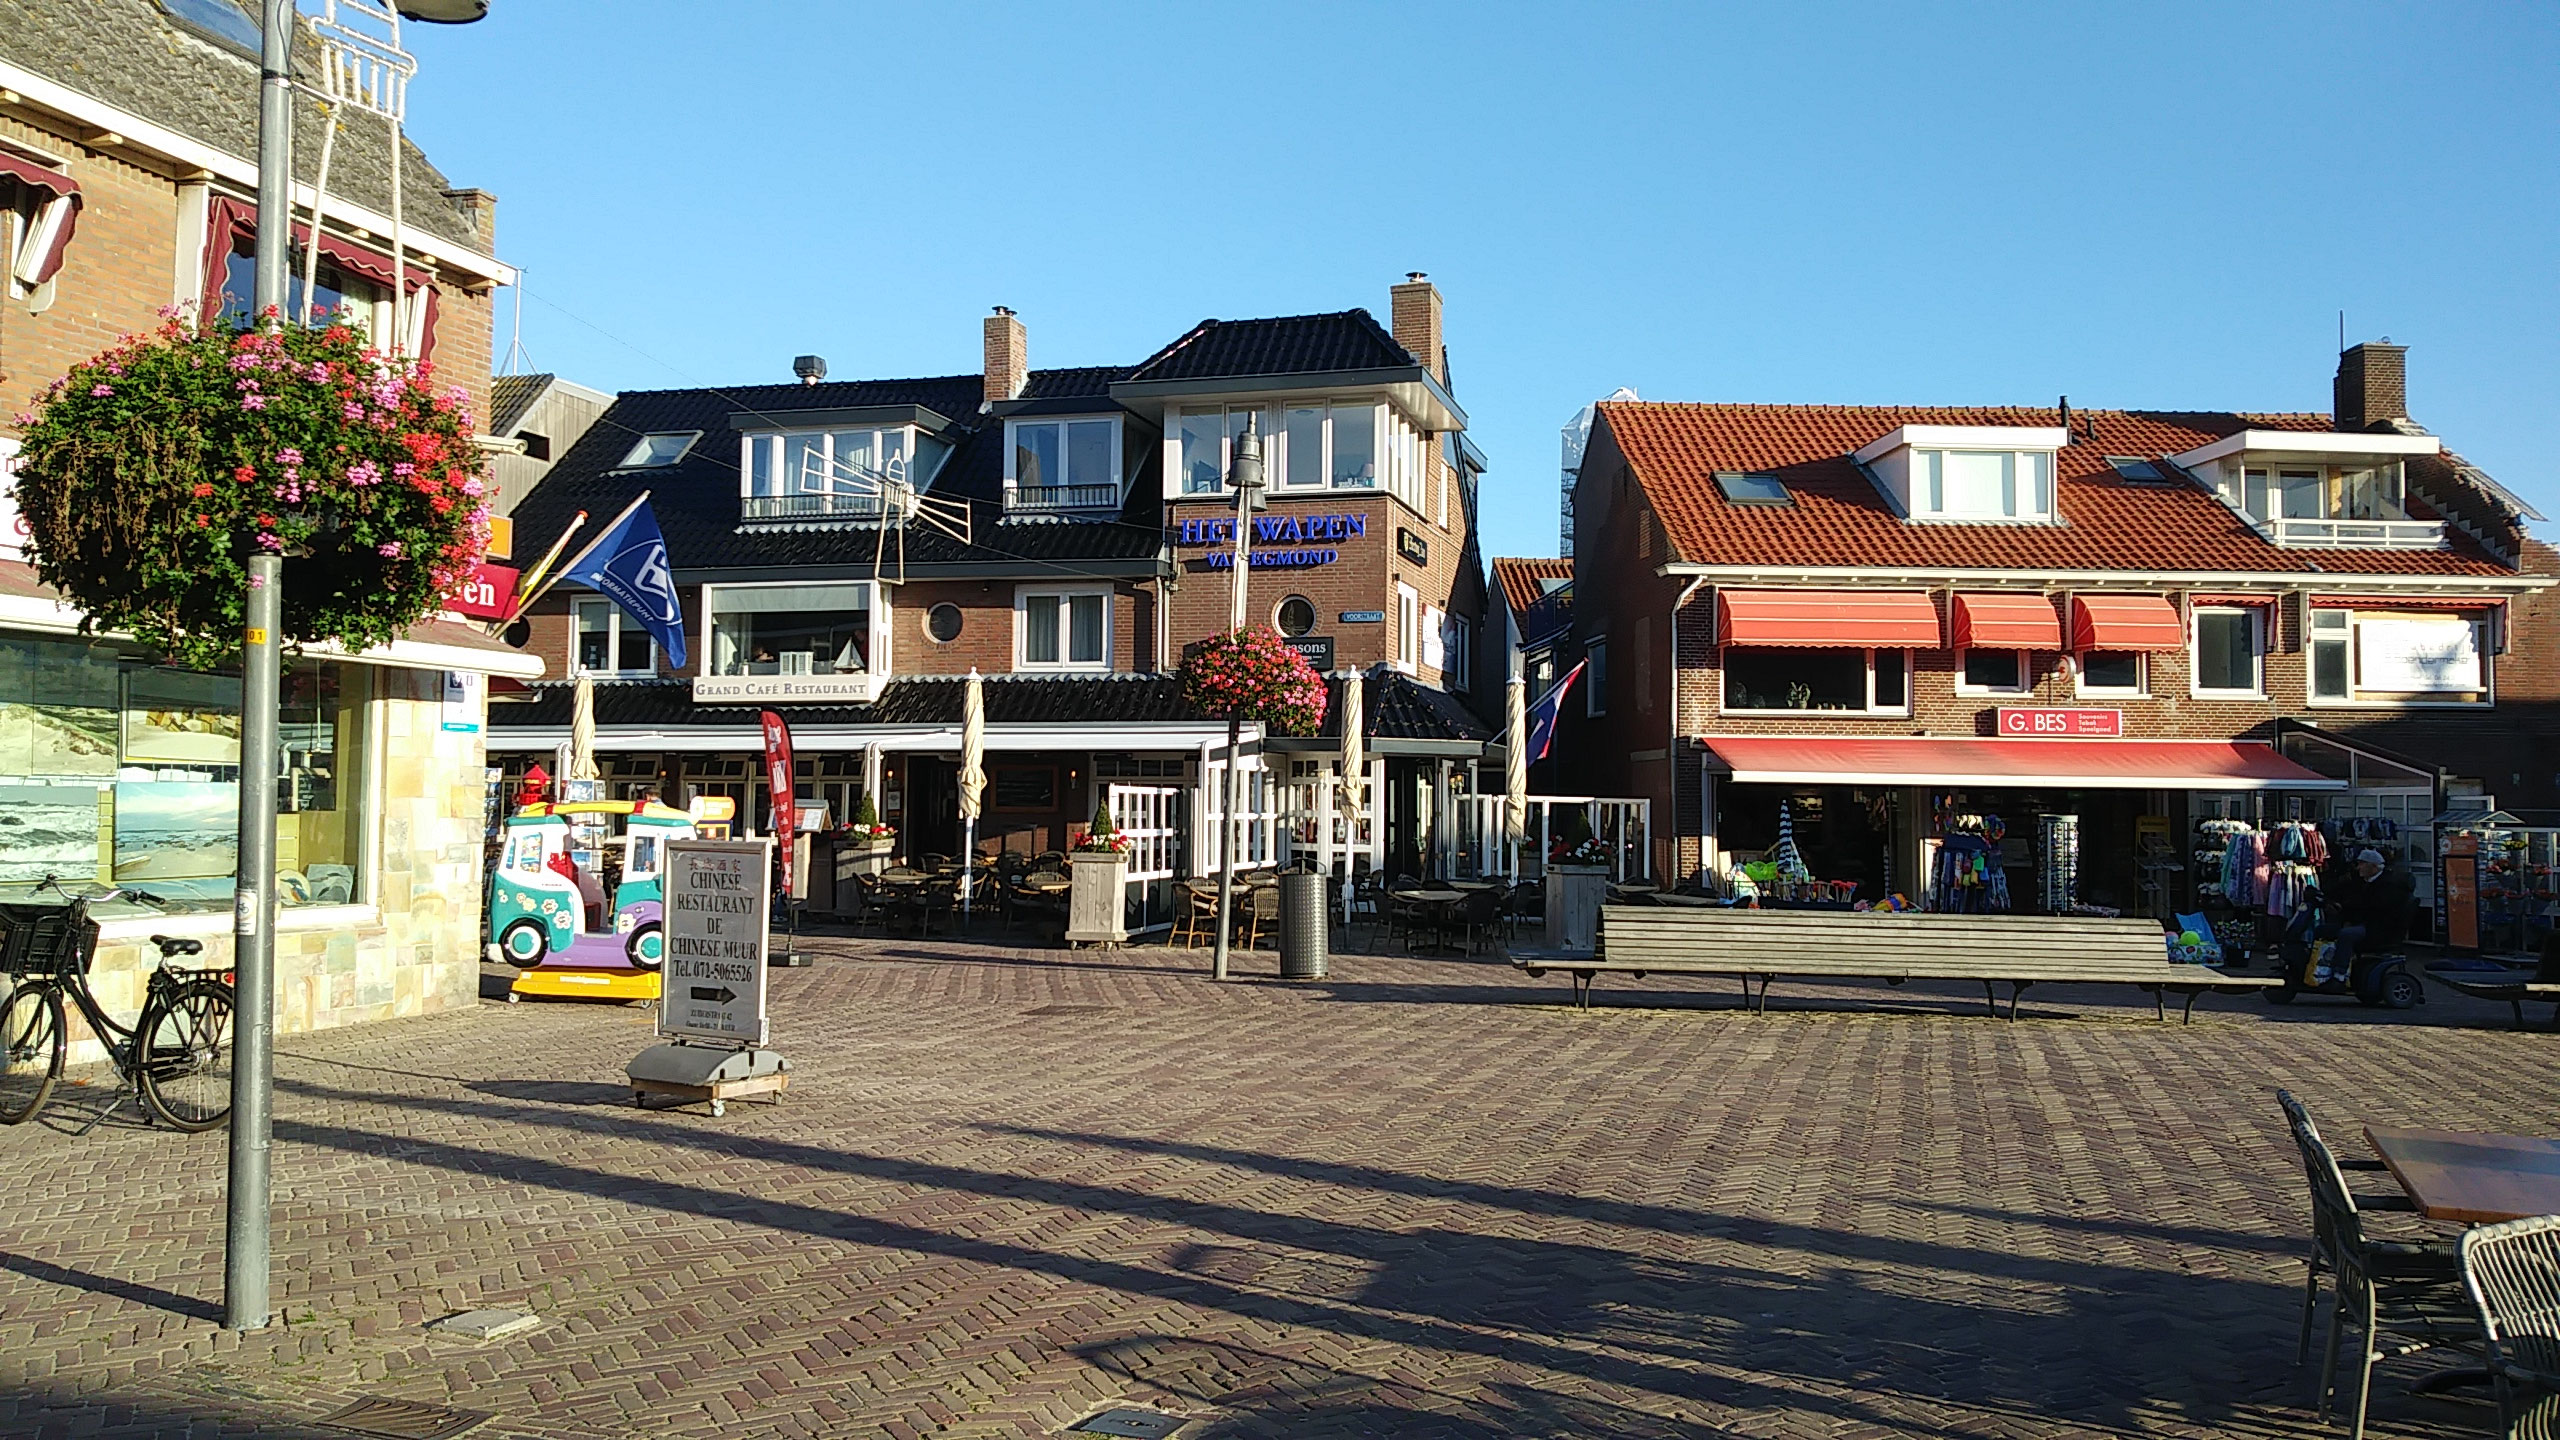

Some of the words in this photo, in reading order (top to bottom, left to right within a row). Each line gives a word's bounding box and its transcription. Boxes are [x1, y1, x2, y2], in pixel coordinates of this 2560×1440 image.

[1180, 518, 1238, 542] HET
[1255, 513, 1369, 541] WAPEN
[1250, 549, 1338, 566] EGMOND
[695, 684, 741, 695] GRAND
[745, 683, 779, 695] CAFÉ
[784, 683, 866, 695] RESTAURANT
[2008, 713, 2029, 732] G.
[2034, 713, 2067, 732] BES
[690, 872, 742, 891] CHINESE
[677, 893, 755, 914] RESTAURANT
[707, 917, 723, 935] DE
[670, 937, 720, 957] CHINESE
[723, 940, 757, 960] MUUR
[674, 960, 691, 977] Tel.
[693, 961, 753, 982] 072-5065526
